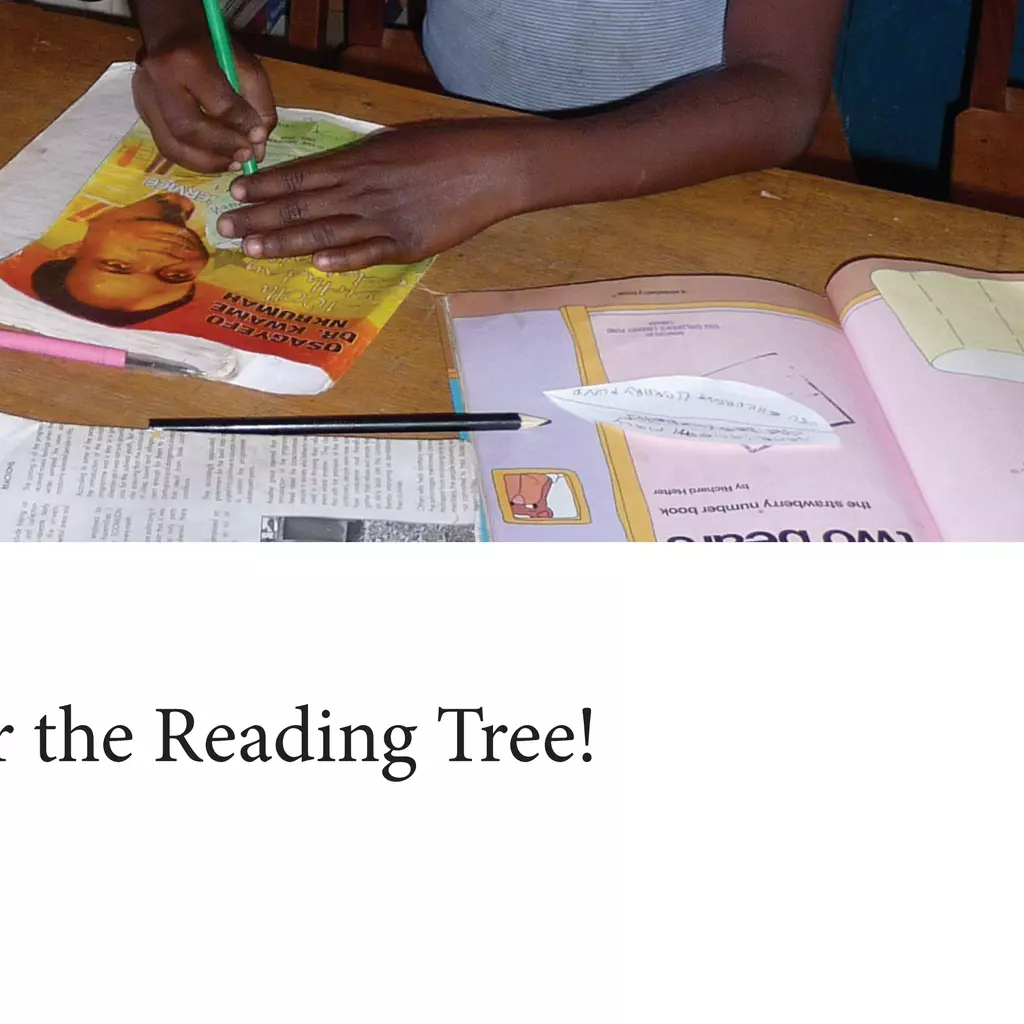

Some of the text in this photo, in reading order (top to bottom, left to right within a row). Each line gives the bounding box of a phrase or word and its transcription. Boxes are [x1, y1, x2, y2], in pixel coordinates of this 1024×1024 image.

[211, 300, 315, 336] KWAME
[220, 290, 350, 329] NKRUMAH
[204, 312, 344, 356] OSAGYEFO
[689, 484, 733, 494] Richard
[735, 482, 749, 491] by
[658, 498, 870, 516] the strawberry number book
